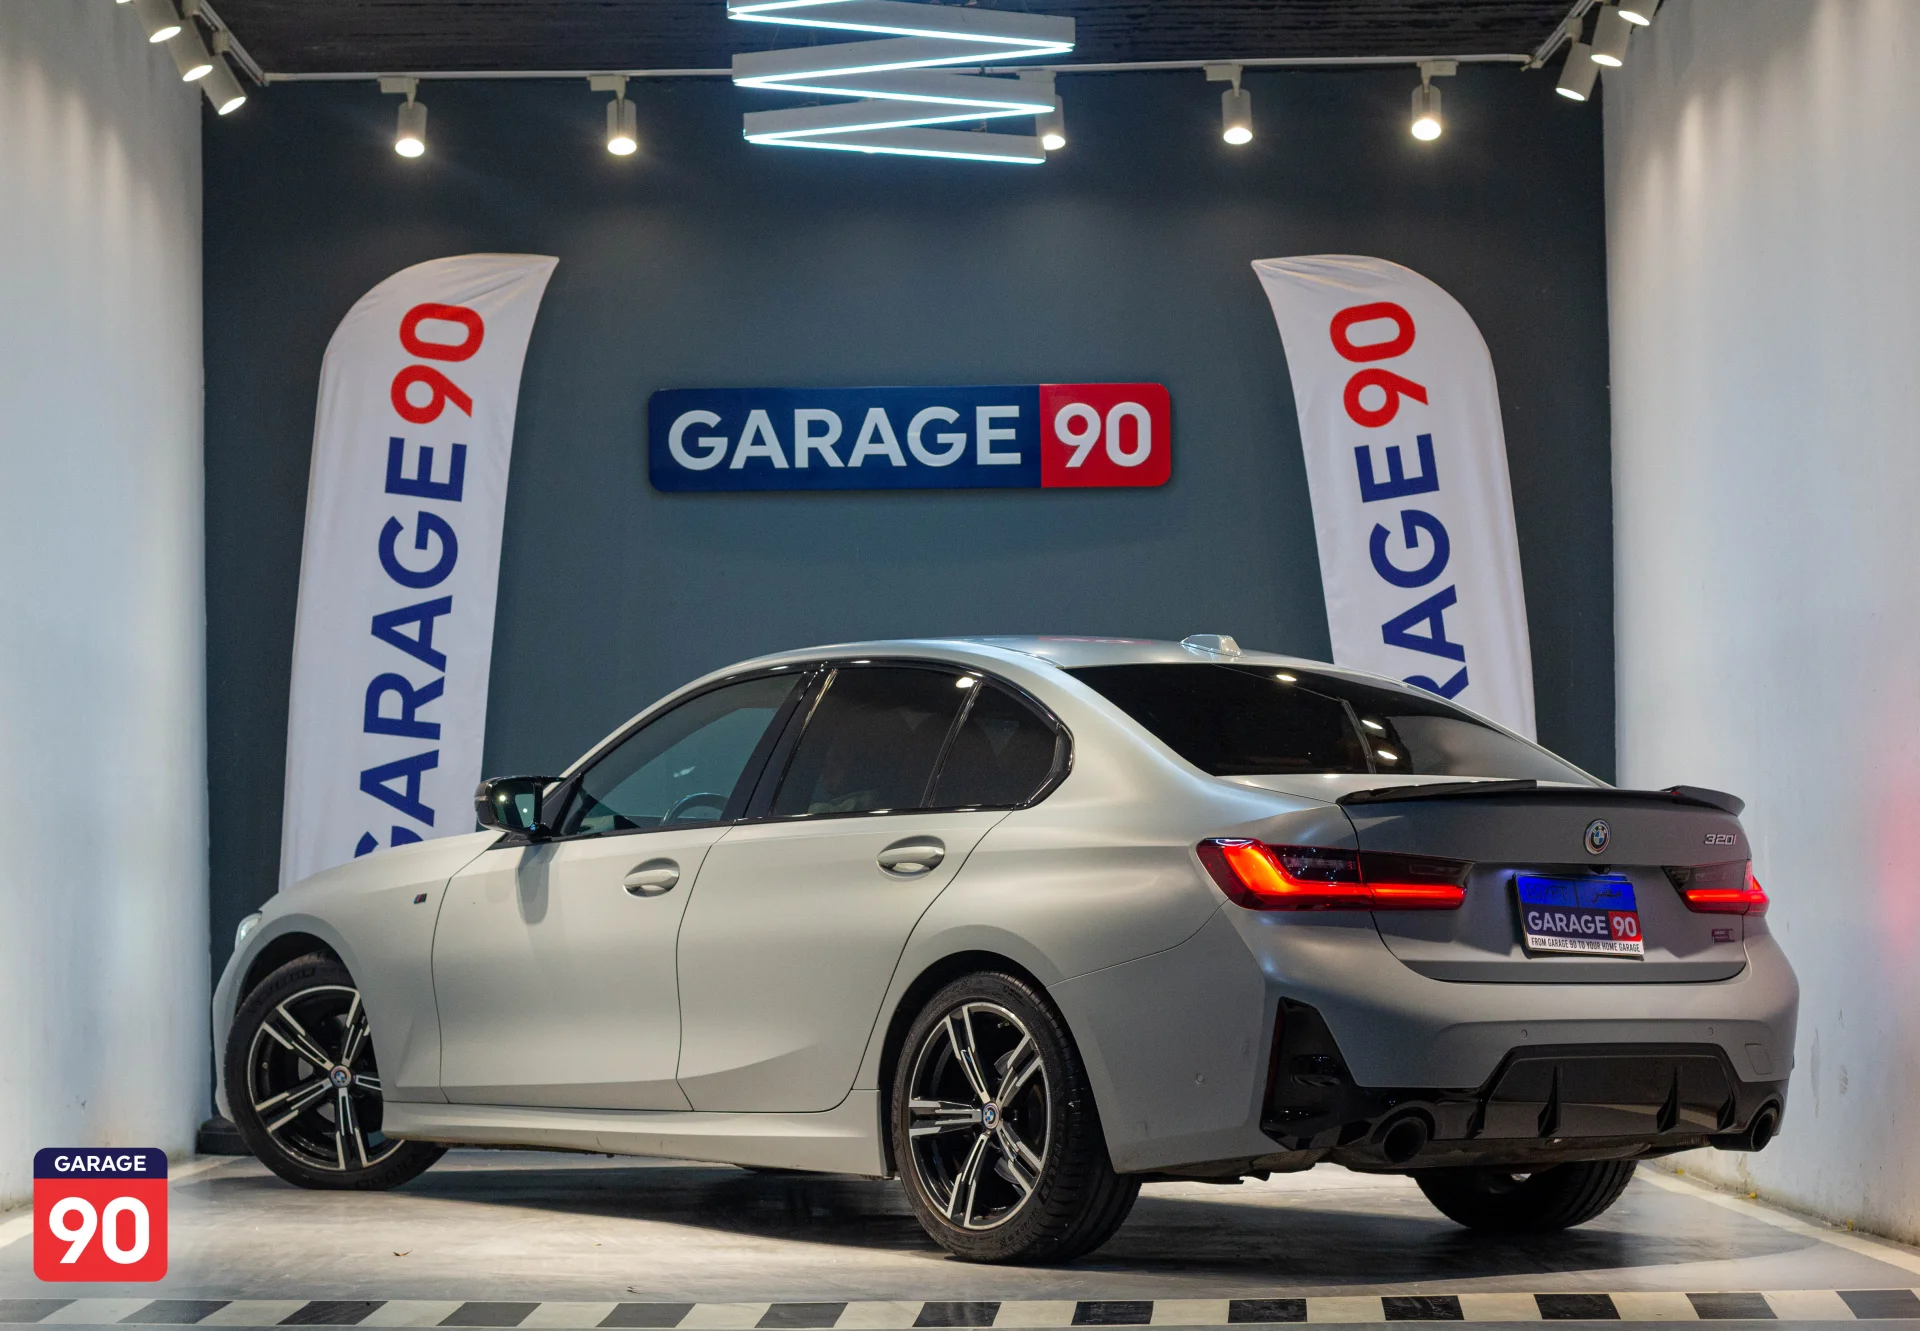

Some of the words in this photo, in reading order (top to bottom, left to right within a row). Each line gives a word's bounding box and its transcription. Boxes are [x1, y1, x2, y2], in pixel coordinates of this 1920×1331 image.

[668, 405, 1022, 471] GARAGE
[1053, 401, 1152, 468] 90
[353, 437, 468, 858] ARAGE
[1525, 883, 1567, 899] EGYPT
[1592, 888, 1622, 902] مصر
[1527, 911, 1608, 935] GARAGE
[1612, 916, 1638, 937] 90
[1531, 937, 1547, 946] FROM
[1547, 938, 1569, 949] GARAGE
[1570, 940, 1577, 948] 90
[1578, 940, 1586, 949] TO
[1586, 941, 1601, 950] YOUR
[1601, 942, 1618, 951] HOME
[1618, 943, 1641, 953] GARAGE
